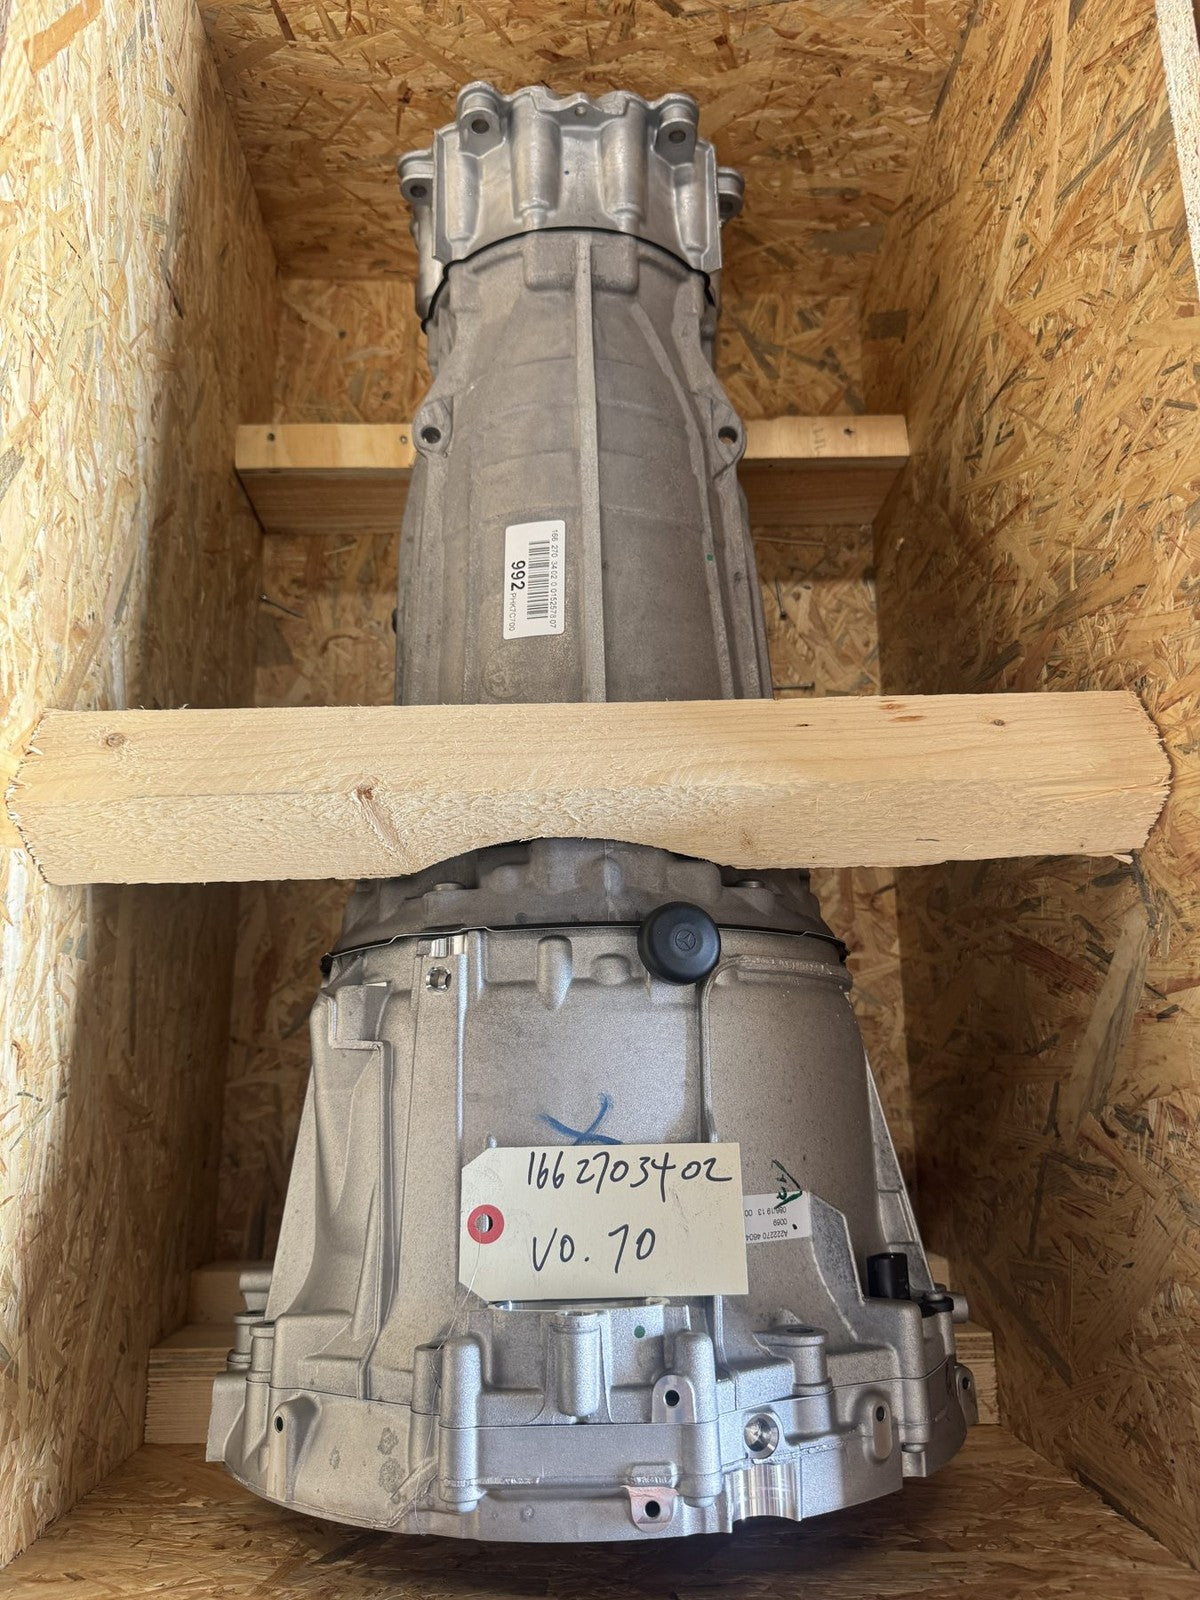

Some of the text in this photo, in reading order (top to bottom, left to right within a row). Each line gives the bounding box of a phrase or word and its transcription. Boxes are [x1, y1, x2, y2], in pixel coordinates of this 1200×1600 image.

[551, 529, 559, 542] 166
[551, 544, 559, 557] 270
[510, 560, 526, 592] 992
